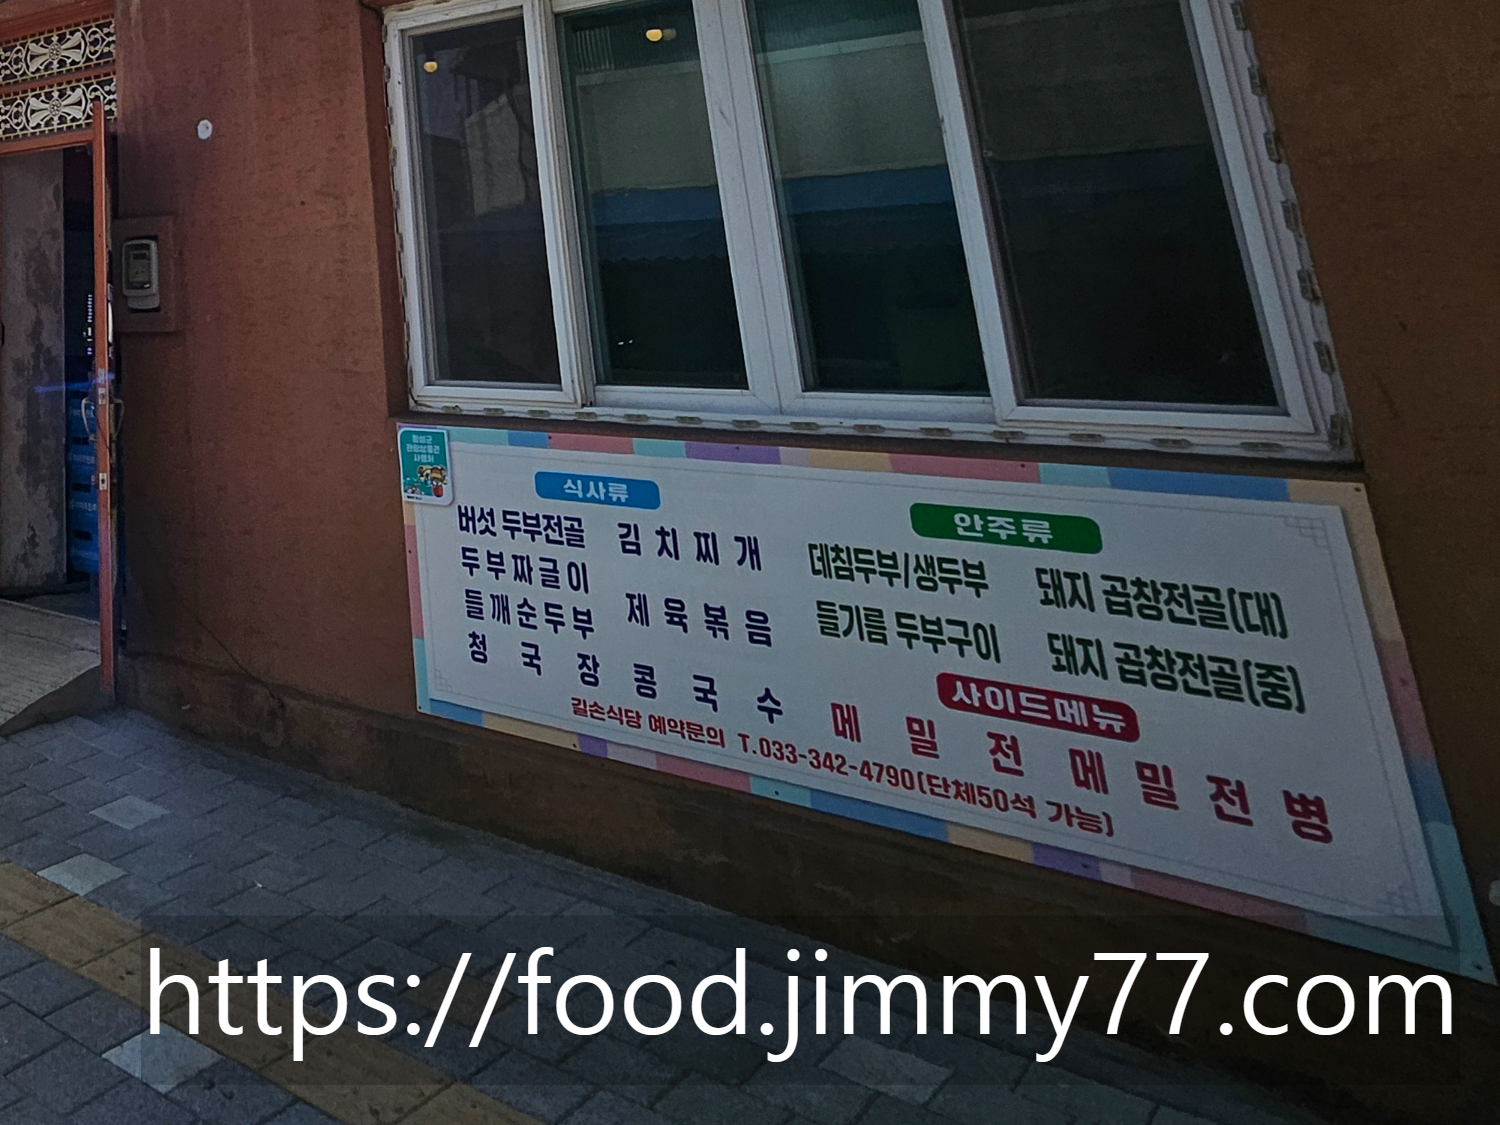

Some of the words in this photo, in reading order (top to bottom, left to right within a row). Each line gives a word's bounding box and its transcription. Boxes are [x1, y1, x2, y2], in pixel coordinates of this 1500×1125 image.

[563, 478, 629, 503] 식사류
[457, 504, 498, 537] 버섯
[501, 509, 586, 549] 두부전골
[953, 512, 1053, 544] 안주류
[461, 545, 589, 595] 두부짜글이
[1035, 567, 1096, 613] 돼지
[464, 588, 595, 640] 들깨순두부
[816, 600, 889, 646] 들기름
[895, 611, 1001, 664] 두부구이
[1046, 632, 1109, 681] 돼지
[951, 680, 1126, 734] 사이드메뉴
[570, 696, 642, 729] 길손식당
[648, 713, 726, 748] 예약문의
[1045, 800, 1115, 838] 가능)
